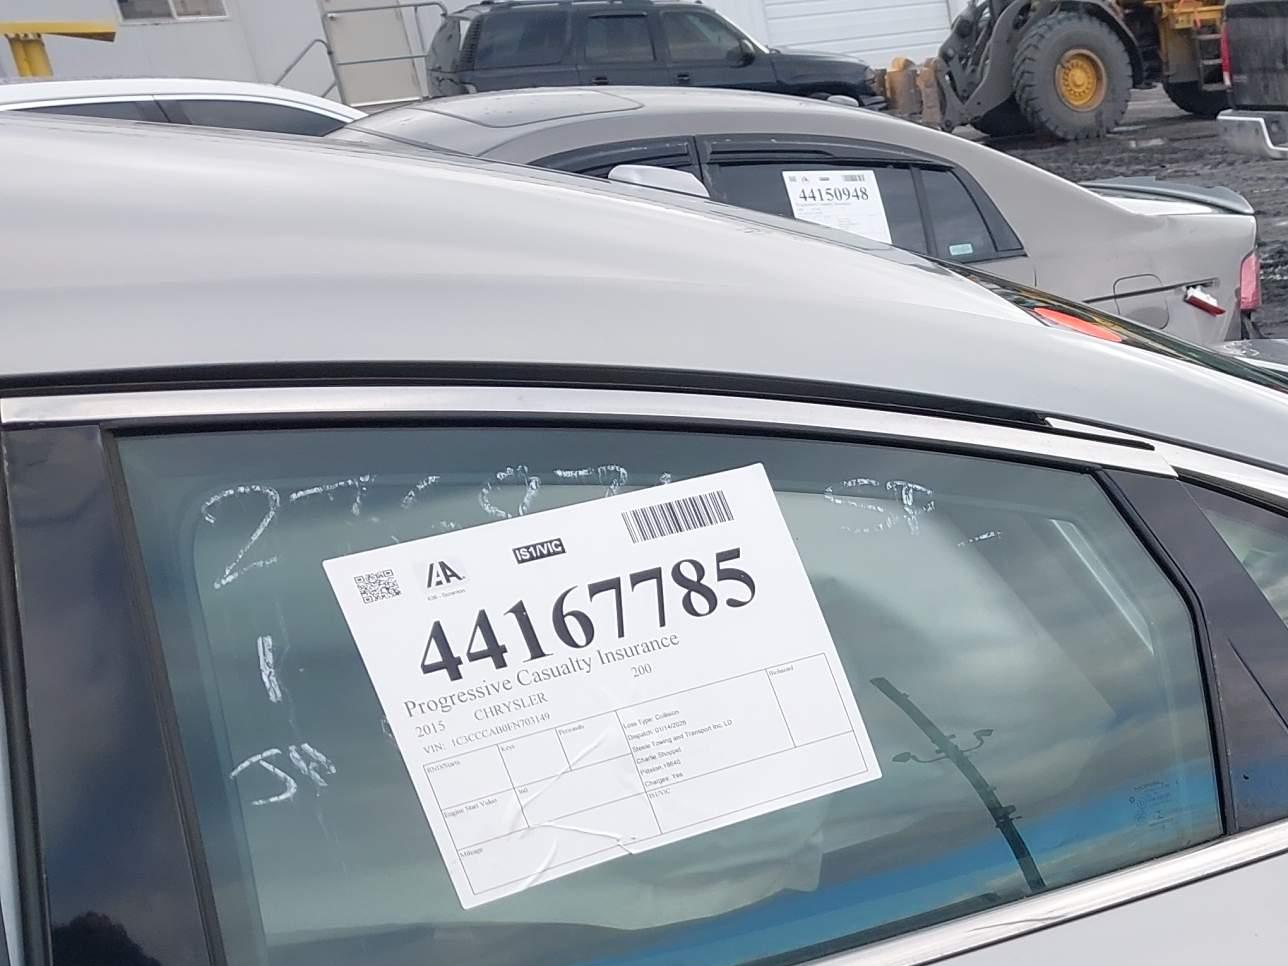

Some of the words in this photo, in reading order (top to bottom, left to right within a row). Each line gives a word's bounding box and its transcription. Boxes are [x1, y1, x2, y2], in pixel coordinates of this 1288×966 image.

[799, 187, 869, 201] 44150948
[515, 540, 564, 561] IS1/VIC
[421, 547, 756, 682] 44167785
[404, 678, 513, 717] Progressive
[516, 655, 592, 687] Casualty
[598, 632, 681, 665] Insurance
[415, 720, 446, 738] 2015
[473, 692, 549, 721] CHRYSLER
[631, 663, 653, 678] 200
[423, 742, 446, 755] VIN:
